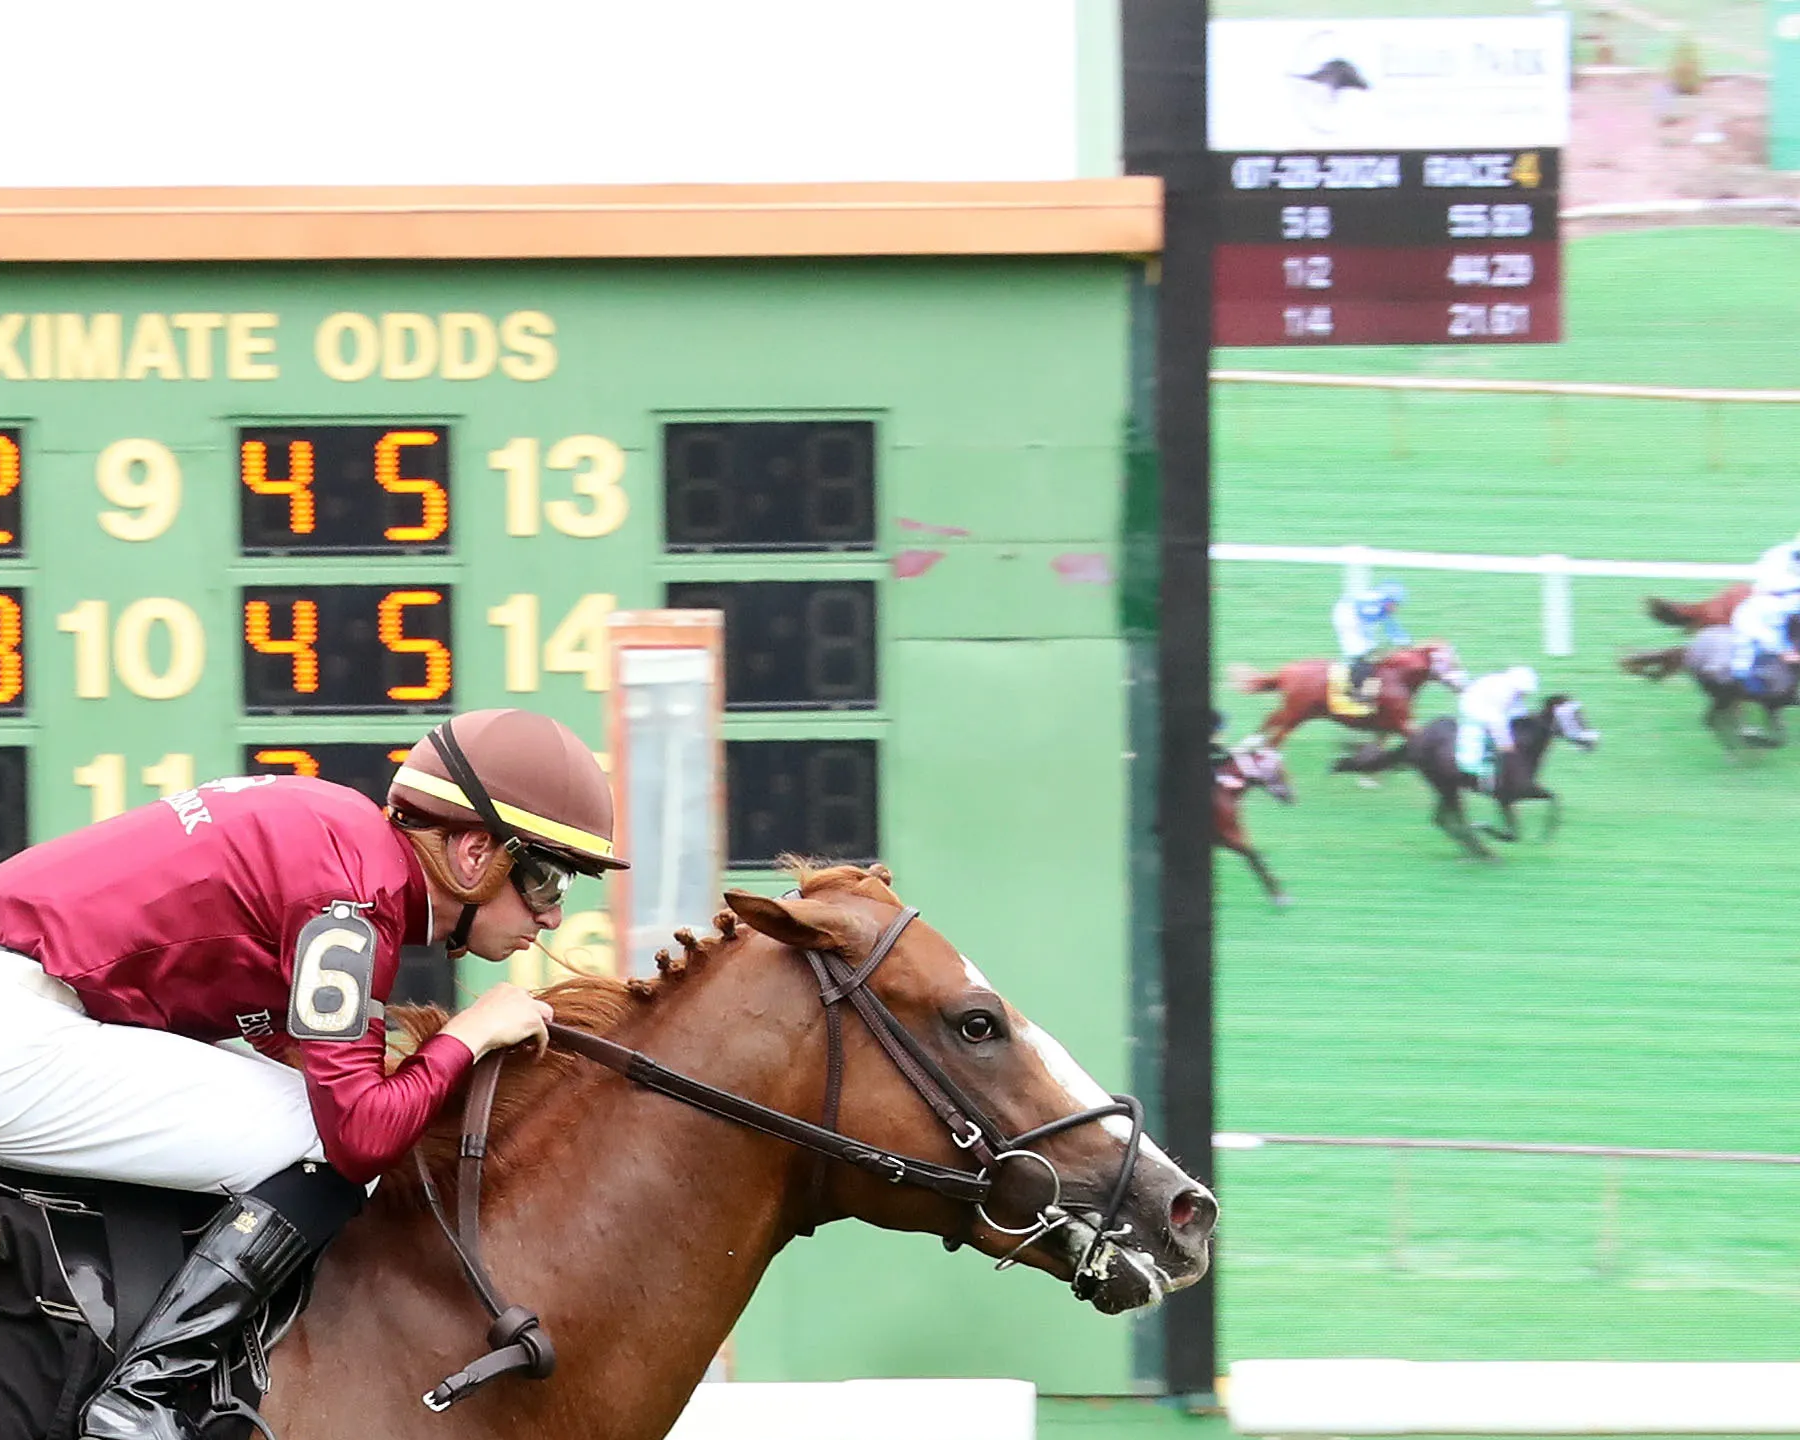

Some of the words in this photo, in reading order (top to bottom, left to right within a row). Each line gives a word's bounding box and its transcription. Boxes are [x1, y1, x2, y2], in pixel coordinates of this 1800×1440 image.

[1509, 153, 1542, 189] 4
[313, 309, 559, 383] ODDS
[94, 436, 184, 542] 9
[487, 433, 631, 539] 13
[55, 595, 207, 700] 10
[486, 592, 616, 692] 14
[295, 927, 368, 1033] 6
